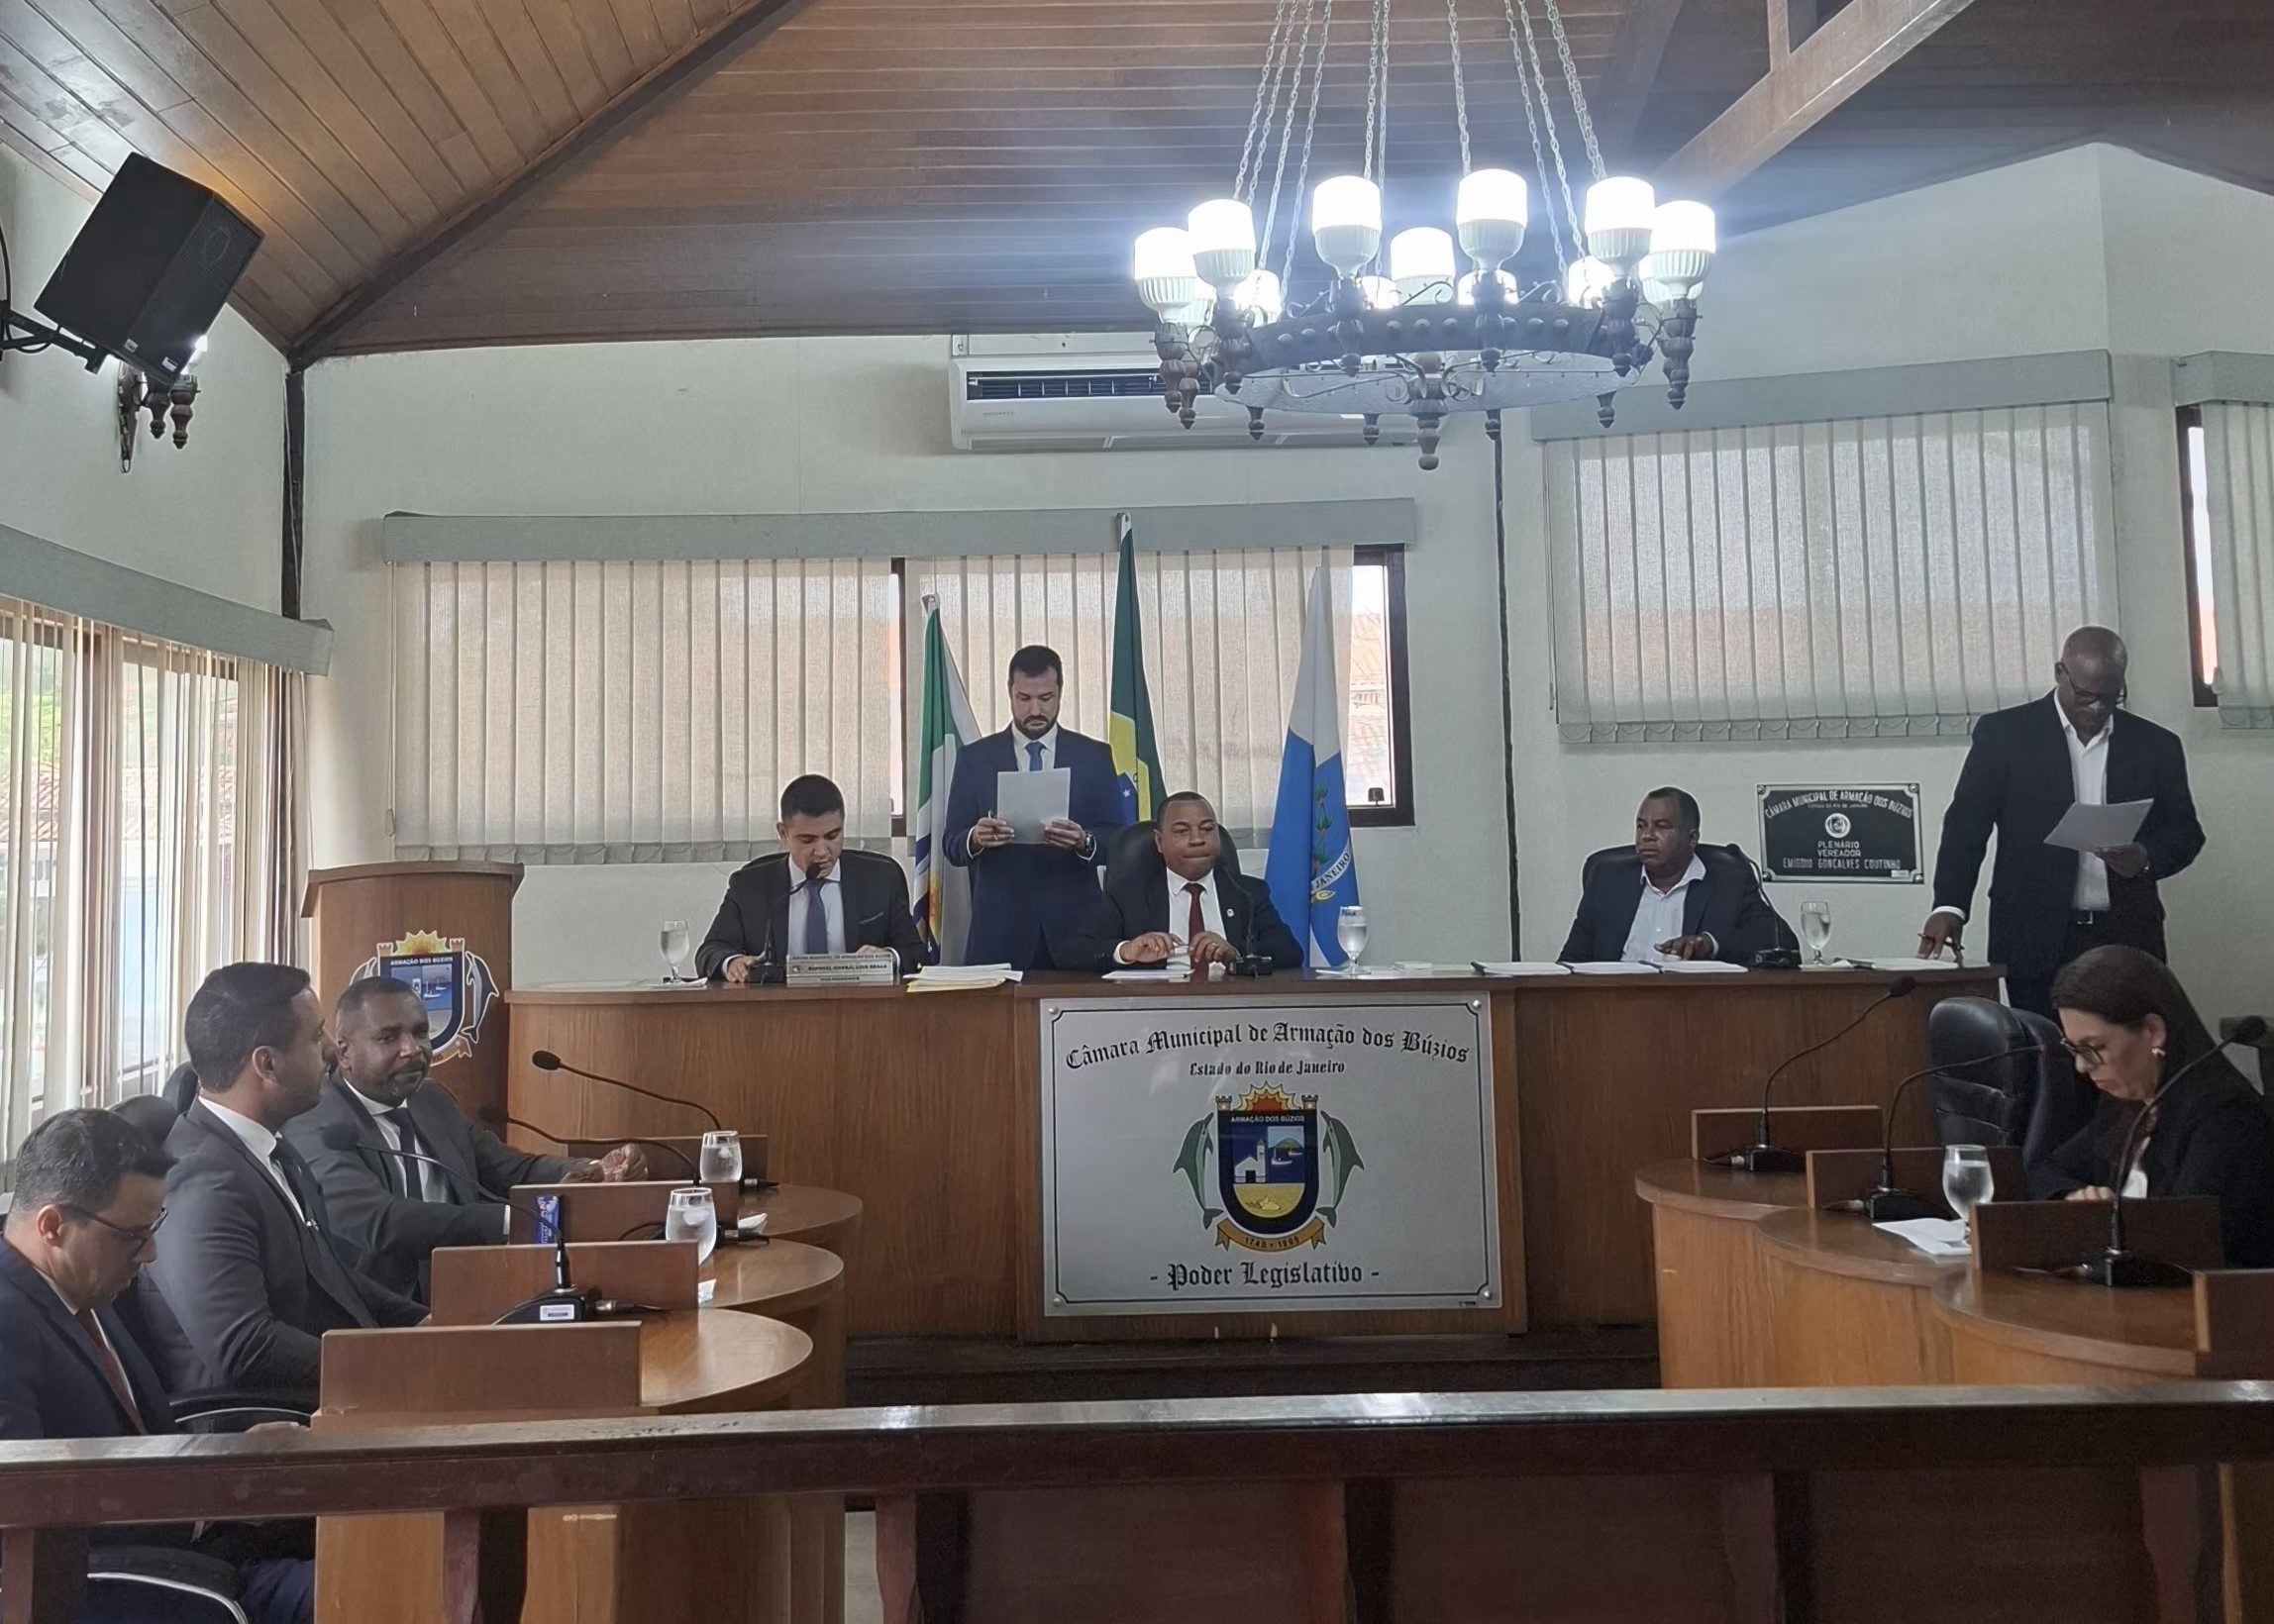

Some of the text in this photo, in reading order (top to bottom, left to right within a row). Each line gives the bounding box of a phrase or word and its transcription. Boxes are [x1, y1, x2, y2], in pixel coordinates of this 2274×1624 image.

[1764, 800, 1792, 819] CÂMARA
[1792, 791, 1828, 807] MUNICIPAL
[1829, 790, 1838, 801] DE
[1840, 790, 1873, 804] ARMAÇÃO
[1873, 795, 1889, 808] DOS
[1817, 840, 1860, 849] PLENÁRIO
[1315, 853, 1350, 889] JANEIRO
[1864, 859, 1901, 869] COUTINHO
[1066, 1022, 1470, 1069] Câmara Municipal de Armação dos Búzios
[1189, 1059, 1345, 1076] Estado do Rio de Janeiro
[1167, 1263, 1232, 1291] Poder
[1239, 1261, 1363, 1288] Legislativo
